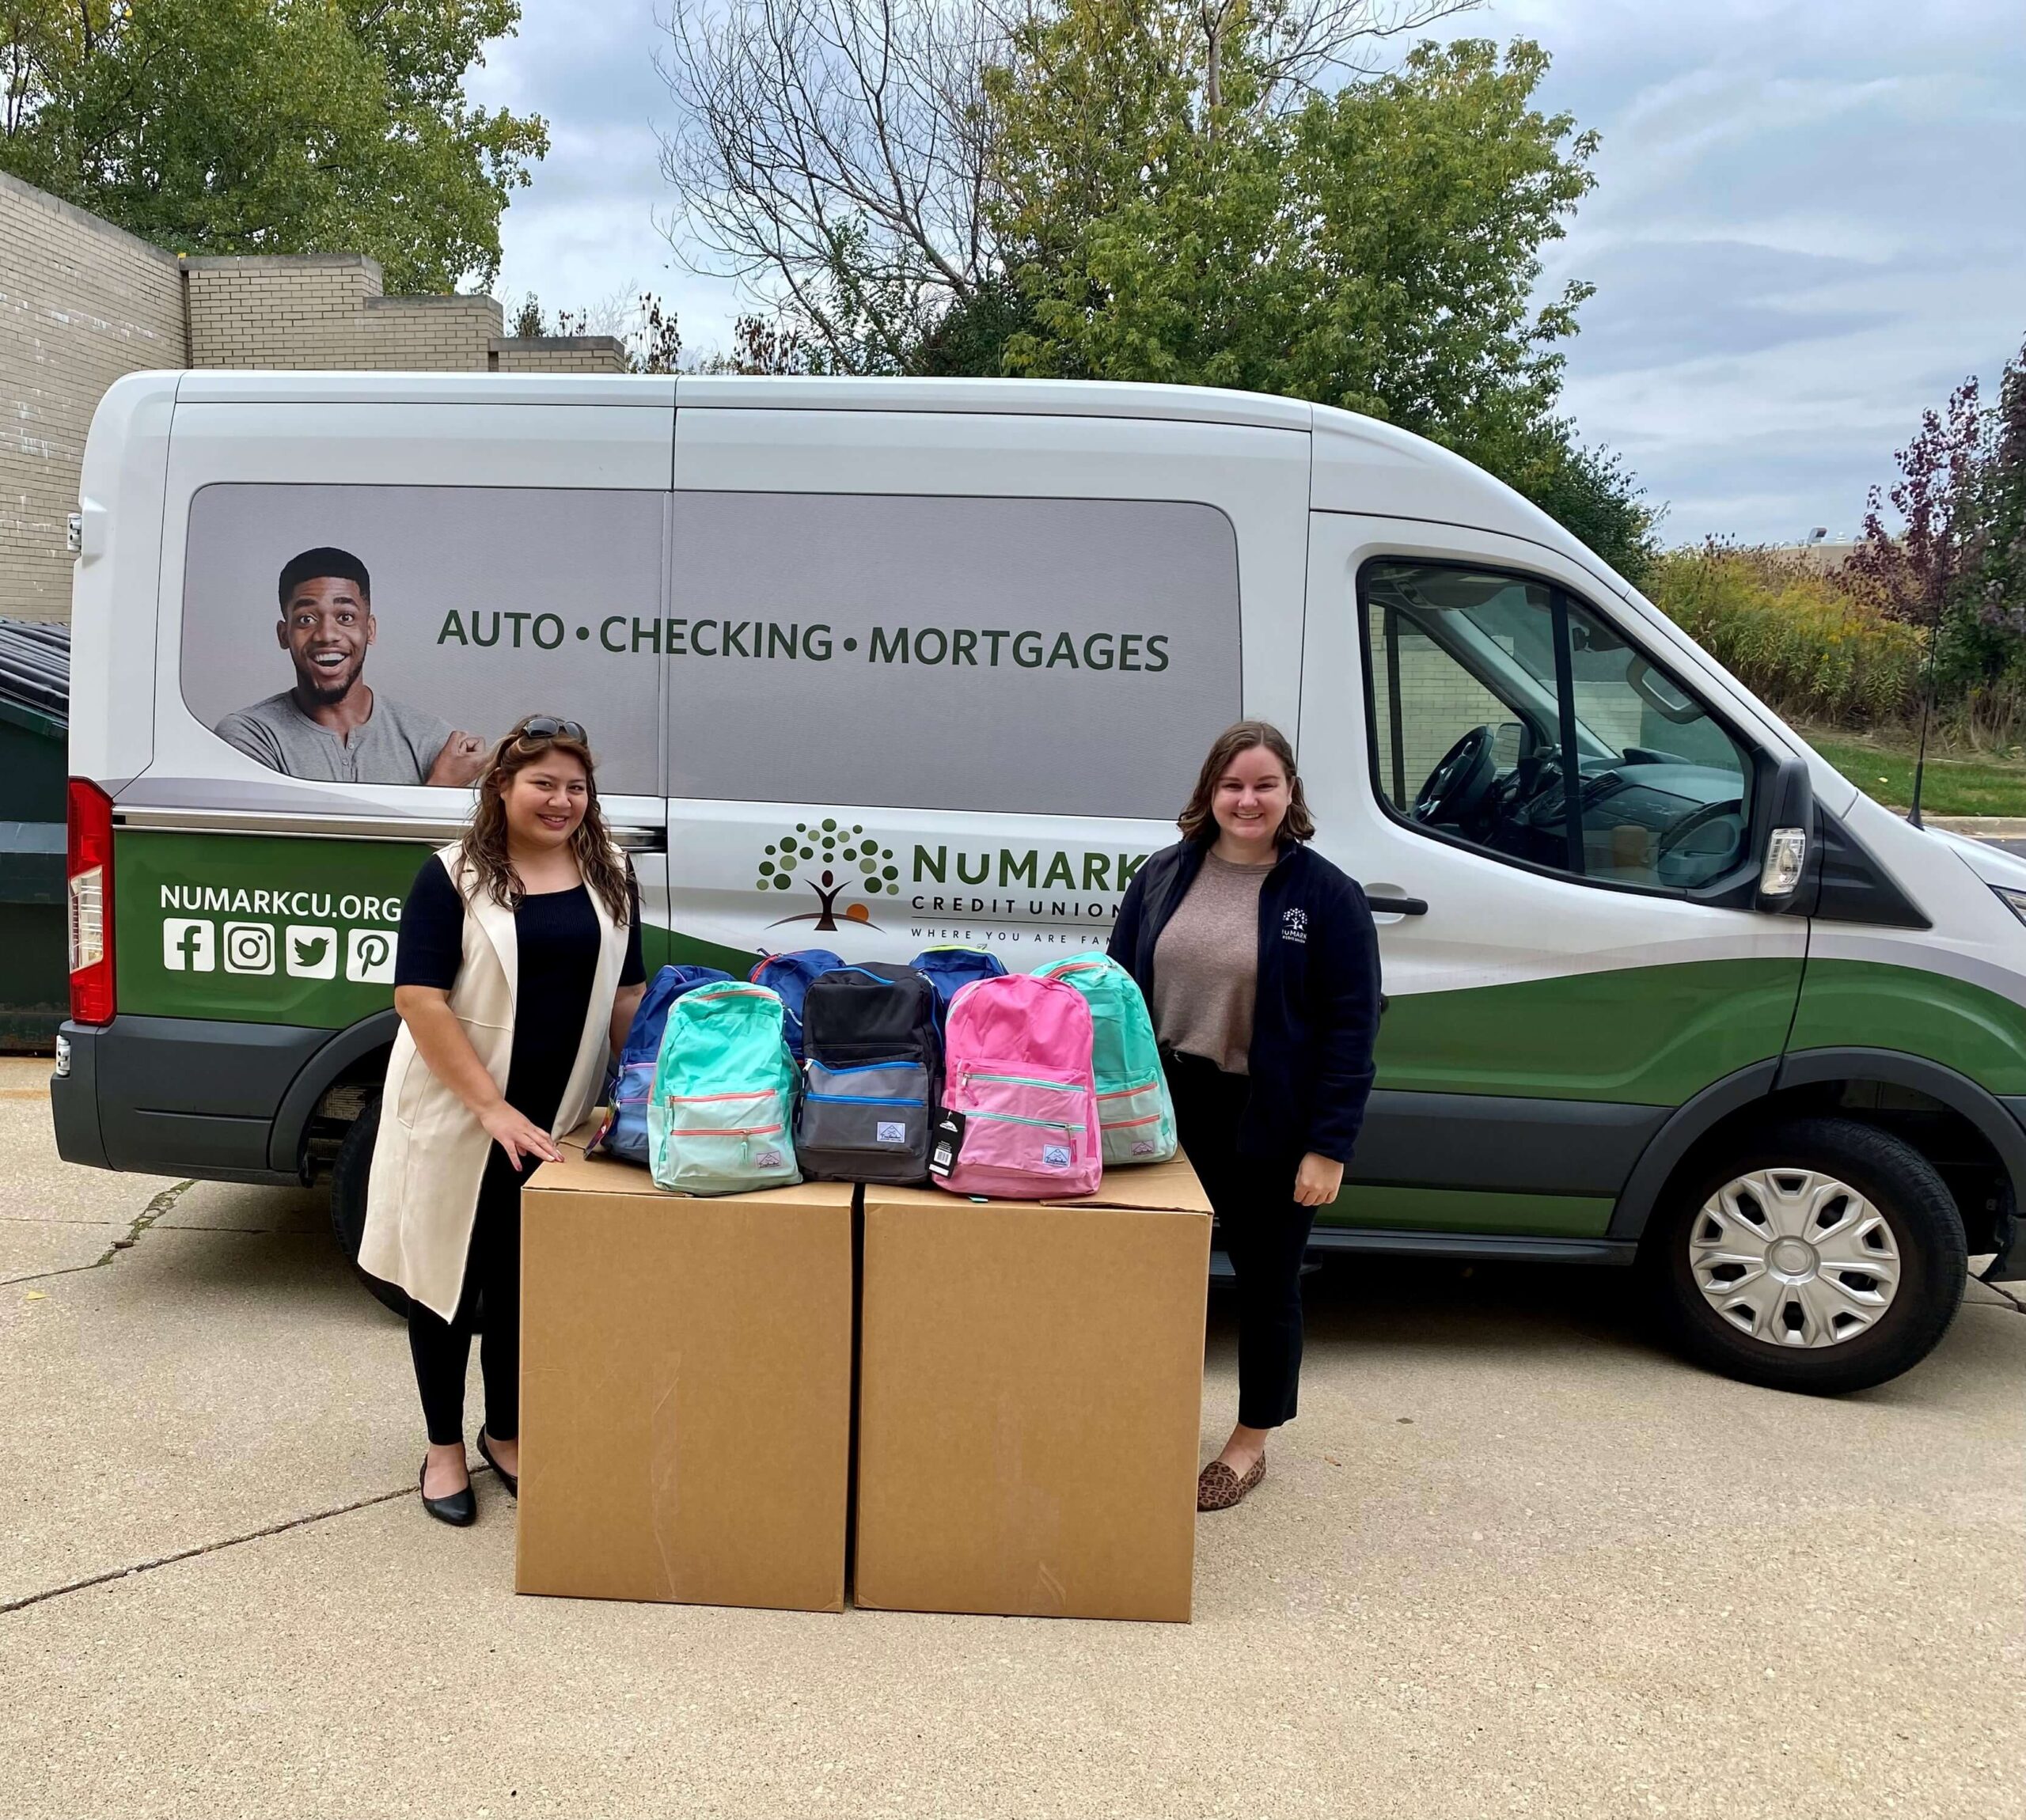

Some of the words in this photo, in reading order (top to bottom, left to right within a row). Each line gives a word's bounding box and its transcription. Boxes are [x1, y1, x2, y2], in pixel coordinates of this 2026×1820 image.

[437, 609, 564, 650] AUTO
[600, 616, 832, 662] CHECKING
[869, 627, 1169, 672] MORTGAGES
[161, 884, 401, 922] NUMARKCU.ORG
[912, 896, 1015, 913] CREDIT
[912, 928, 971, 939] WHERE
[986, 931, 1020, 942] YOU
[1034, 934, 1066, 943] ARE
